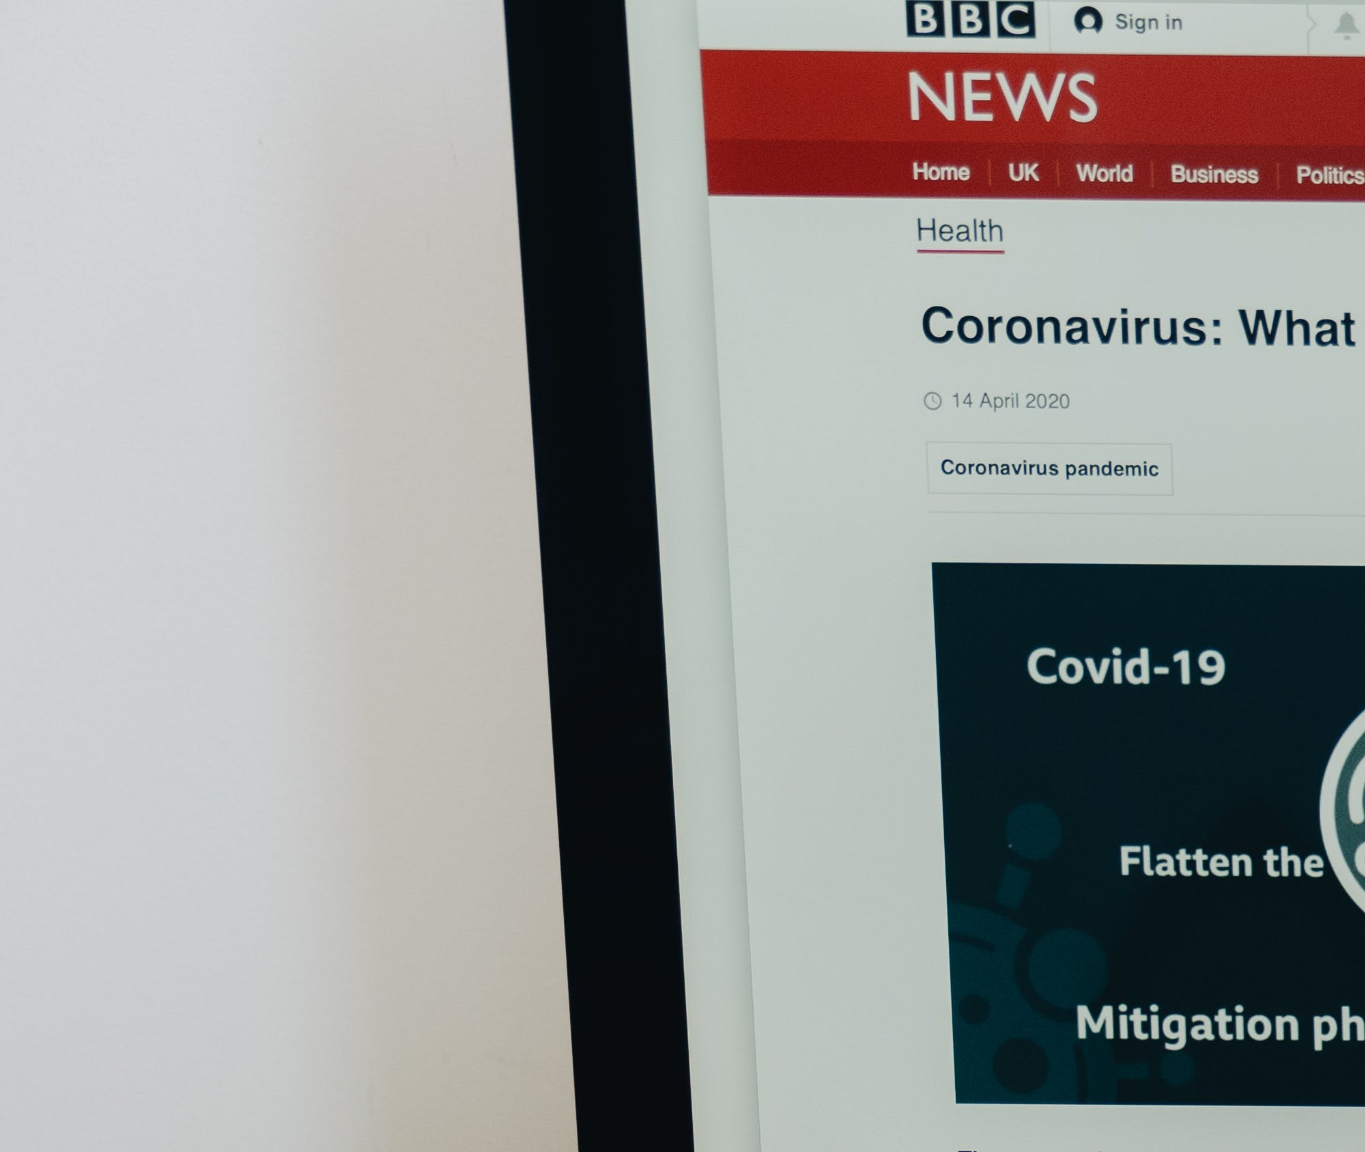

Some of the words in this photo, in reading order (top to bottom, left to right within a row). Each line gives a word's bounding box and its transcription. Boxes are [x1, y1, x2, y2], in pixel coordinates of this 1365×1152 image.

[914, 3, 1030, 34] BBC
[1116, 13, 1158, 34] Sign
[1166, 14, 1182, 30] in
[909, 71, 1097, 122] NEWS
[913, 162, 970, 181] Home
[1009, 163, 1039, 181] UK
[1076, 164, 1133, 182] World
[1171, 164, 1259, 183] Business
[1297, 165, 1365, 184] Politics
[918, 218, 1003, 242] Health
[923, 306, 1220, 345] Coronavirus:
[1238, 310, 1355, 346] What
[953, 393, 973, 407] 14
[980, 393, 1018, 412] April
[1026, 393, 1069, 409] 2020
[941, 459, 1058, 475] Coronavirus
[1066, 461, 1158, 480] pandemic
[1028, 647, 1225, 685] Covid-19
[1121, 845, 1252, 876] Flatten
[1263, 847, 1324, 879] the
[1077, 1004, 1298, 1050] Mitigation
